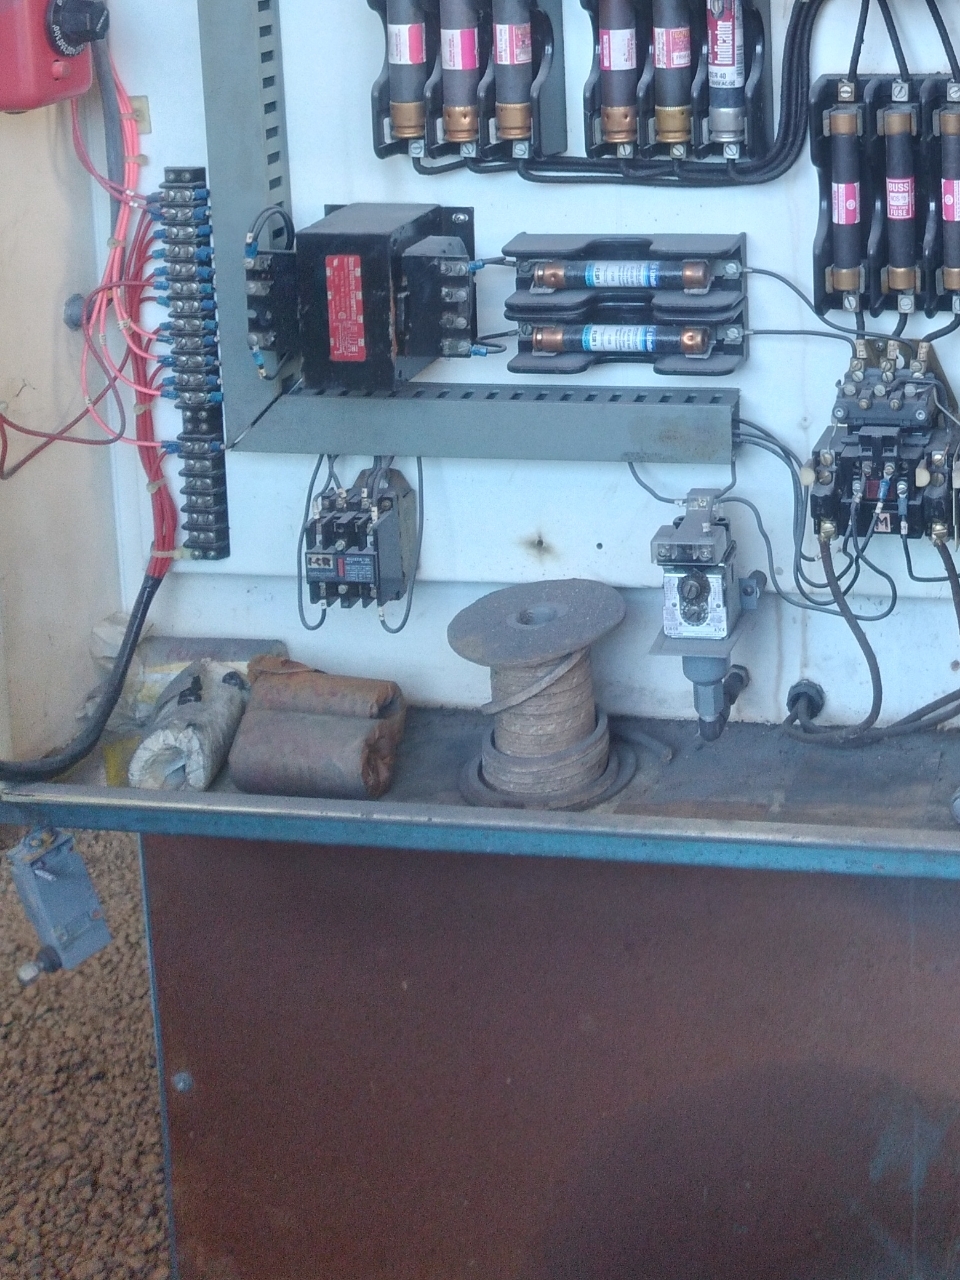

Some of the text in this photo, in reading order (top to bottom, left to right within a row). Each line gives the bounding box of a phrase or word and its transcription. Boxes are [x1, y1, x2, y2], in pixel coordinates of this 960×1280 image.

[715, 21, 733, 65] Indicator
[889, 182, 909, 192] BUSS
[875, 517, 889, 531] M
